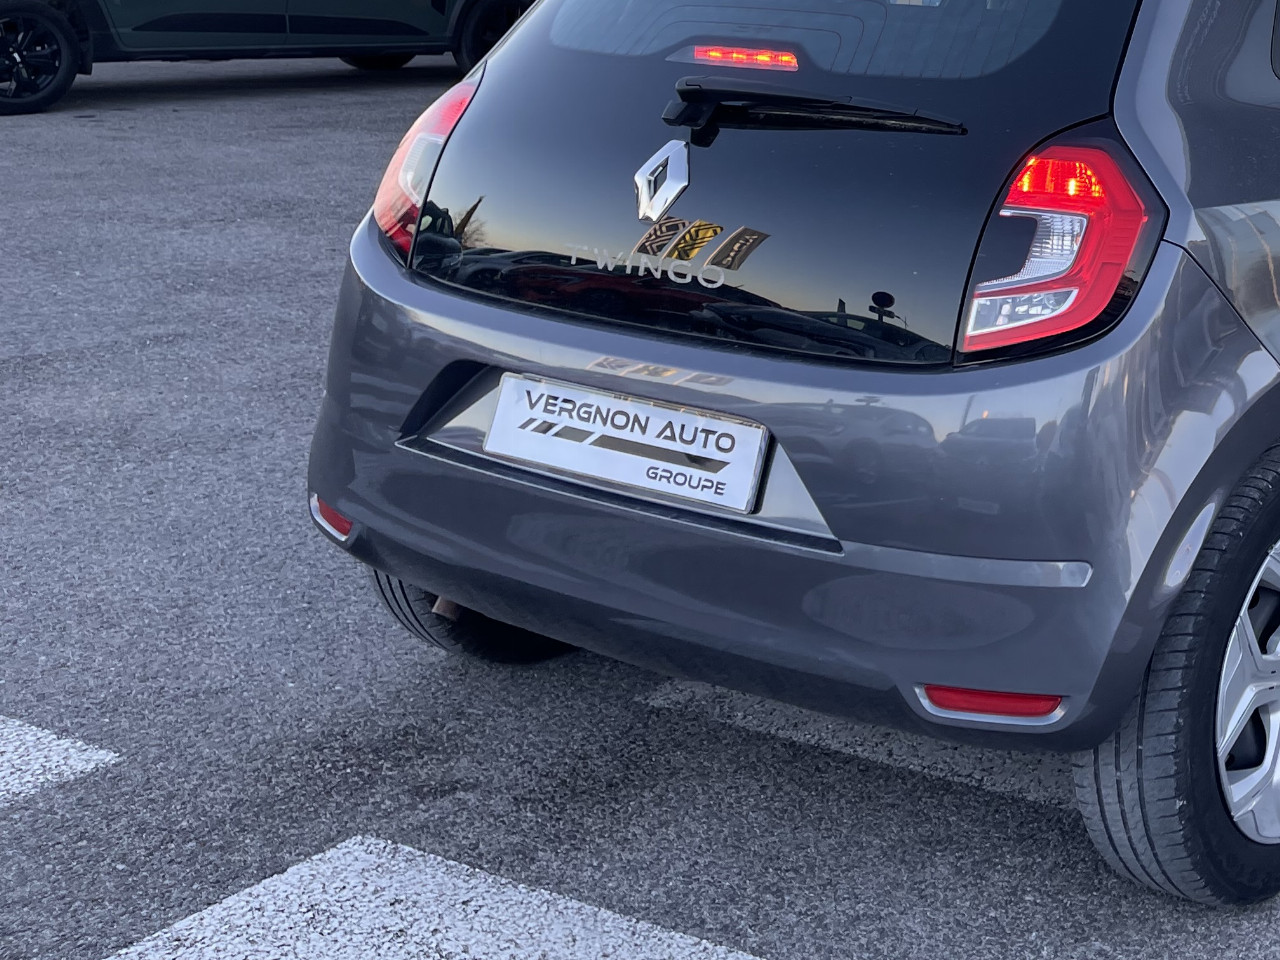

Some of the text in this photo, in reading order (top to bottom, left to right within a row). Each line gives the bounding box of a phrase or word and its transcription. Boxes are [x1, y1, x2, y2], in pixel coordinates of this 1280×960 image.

[565, 242, 725, 289] TWINGO
[525, 389, 736, 454] VERGNON AUTO
[645, 465, 727, 497] GROUPE
